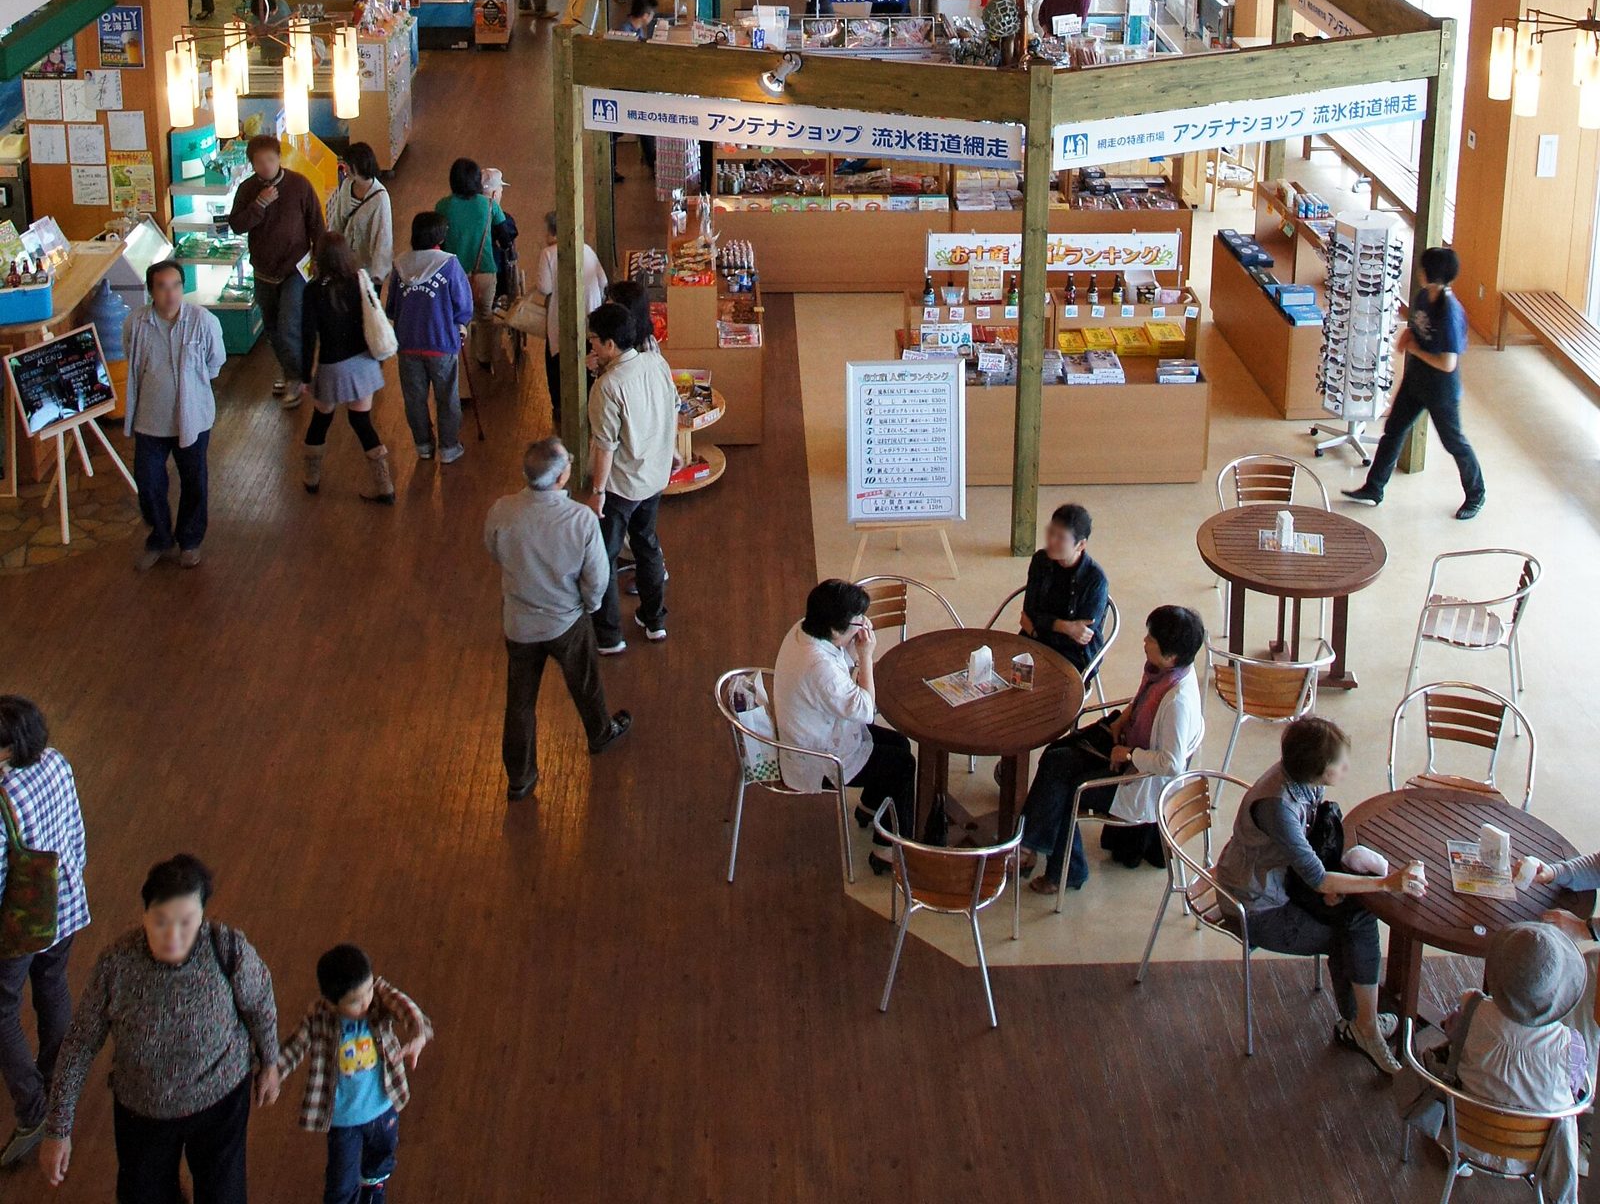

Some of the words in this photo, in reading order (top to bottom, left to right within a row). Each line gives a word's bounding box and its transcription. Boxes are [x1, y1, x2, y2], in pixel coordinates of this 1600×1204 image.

[1097, 131, 1165, 150] 網走の特産市場
[1172, 107, 1306, 143] アンテナショップ
[1312, 93, 1418, 124] 流氷街道網走
[627, 110, 699, 126] 網走の特産市場
[707, 111, 865, 144] アンテナショップ
[872, 126, 1009, 159] 流氷街道網走
[1064, 246, 1161, 265] ランキング
[940, 332, 971, 344] しじみ
[909, 372, 949, 382] ランキング
